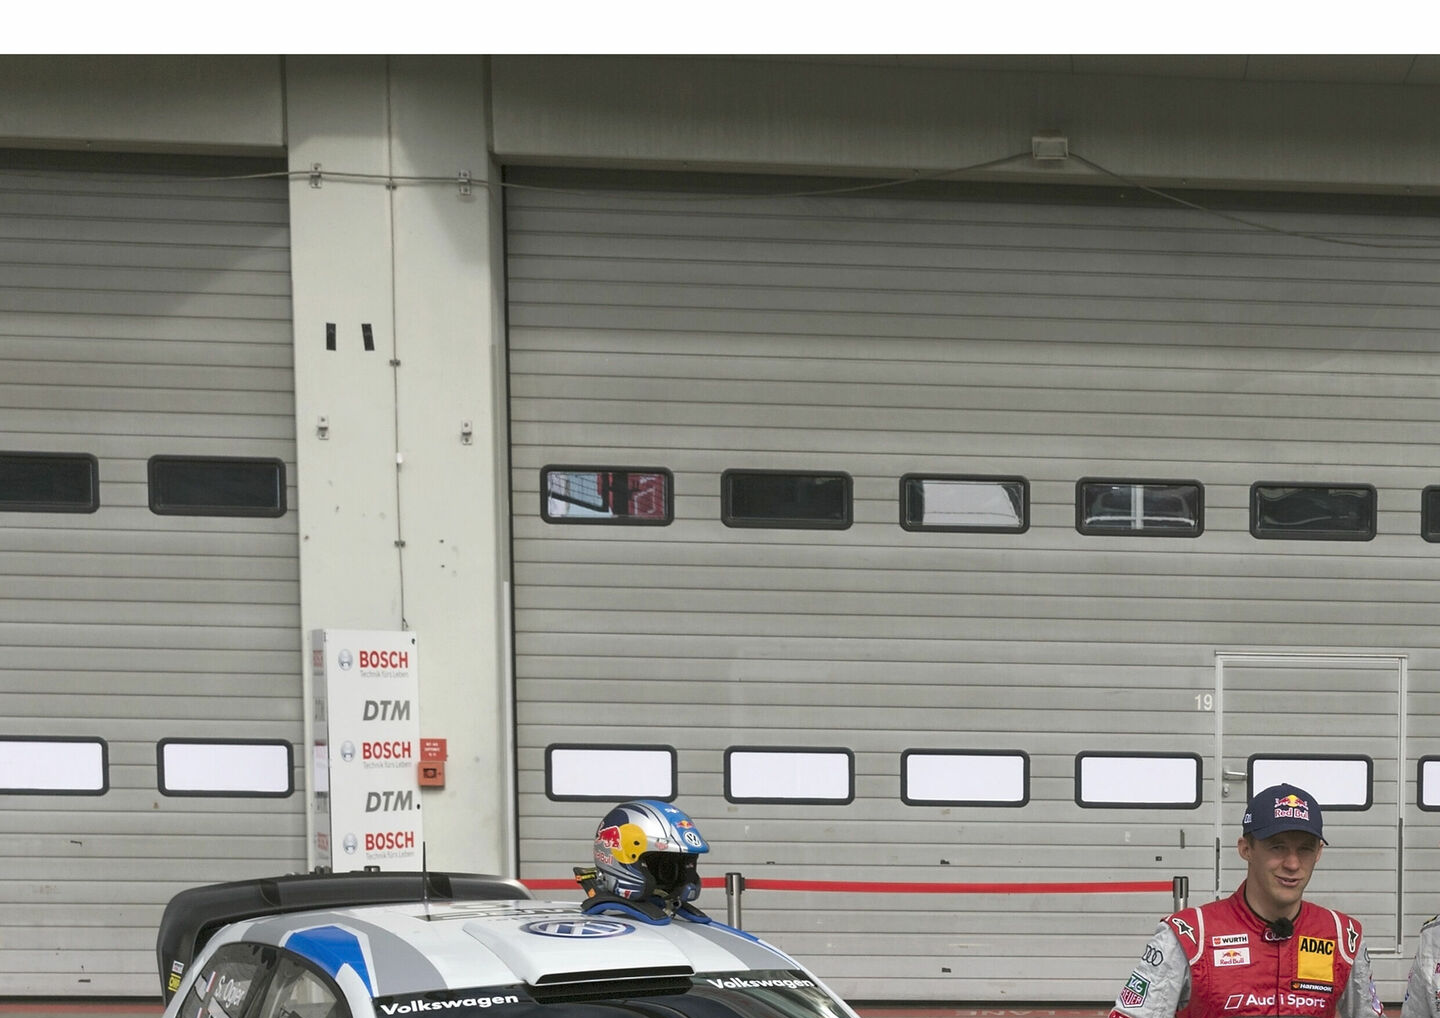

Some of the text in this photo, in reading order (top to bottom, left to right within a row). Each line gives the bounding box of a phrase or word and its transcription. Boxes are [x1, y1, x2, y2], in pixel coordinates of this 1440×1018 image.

[359, 650, 409, 669] BOSCH
[363, 700, 411, 721] DTM
[1194, 694, 1213, 711] 19
[362, 741, 412, 760] BOSCH
[365, 790, 413, 812] DTM
[365, 832, 414, 851] BOSCH
[1300, 938, 1334, 956] ADAC
[706, 977, 815, 992] Volkswagen
[379, 994, 520, 1016] Volkswagen
[1246, 994, 1326, 1008] Audi Sport
